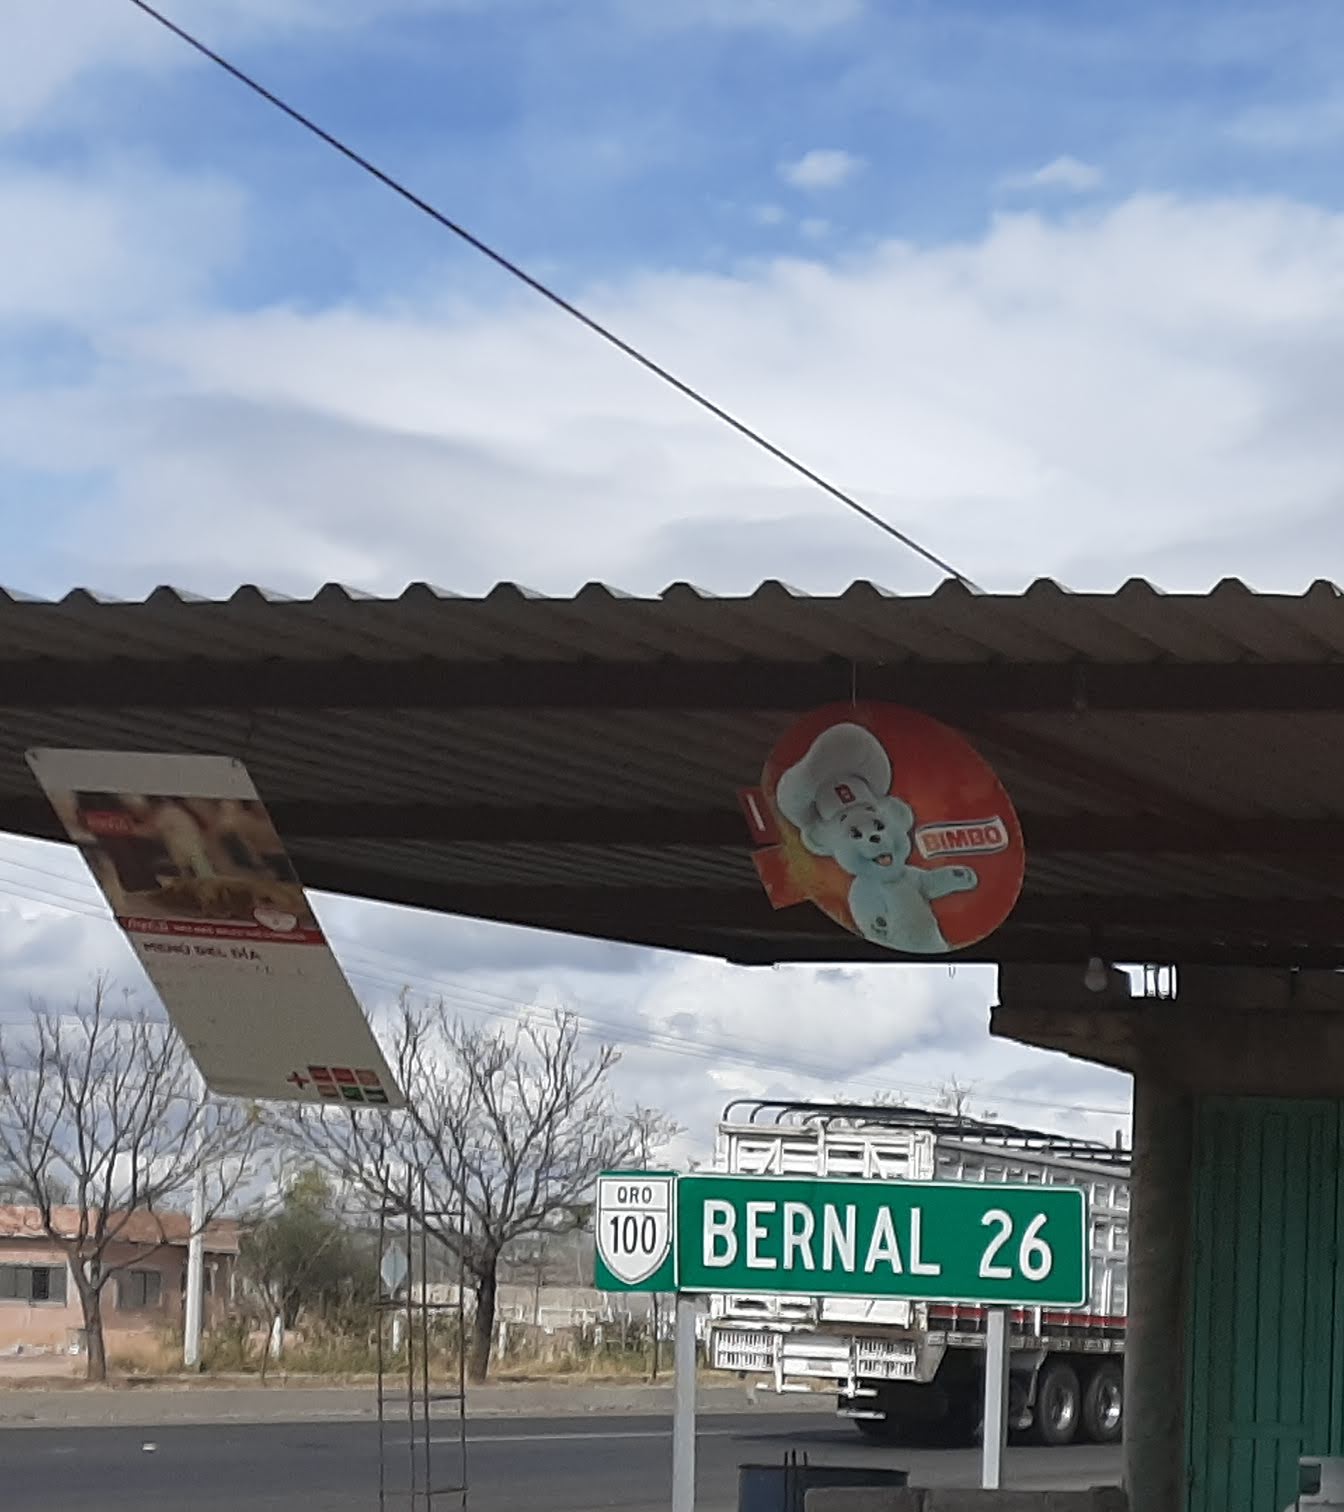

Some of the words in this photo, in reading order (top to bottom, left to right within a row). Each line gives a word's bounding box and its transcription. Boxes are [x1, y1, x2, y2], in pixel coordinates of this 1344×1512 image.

[922, 826, 1002, 851] BIMBO
[610, 1216, 656, 1255] 100
[703, 1199, 941, 1276] BERNAL
[979, 1208, 1052, 1281] 26
